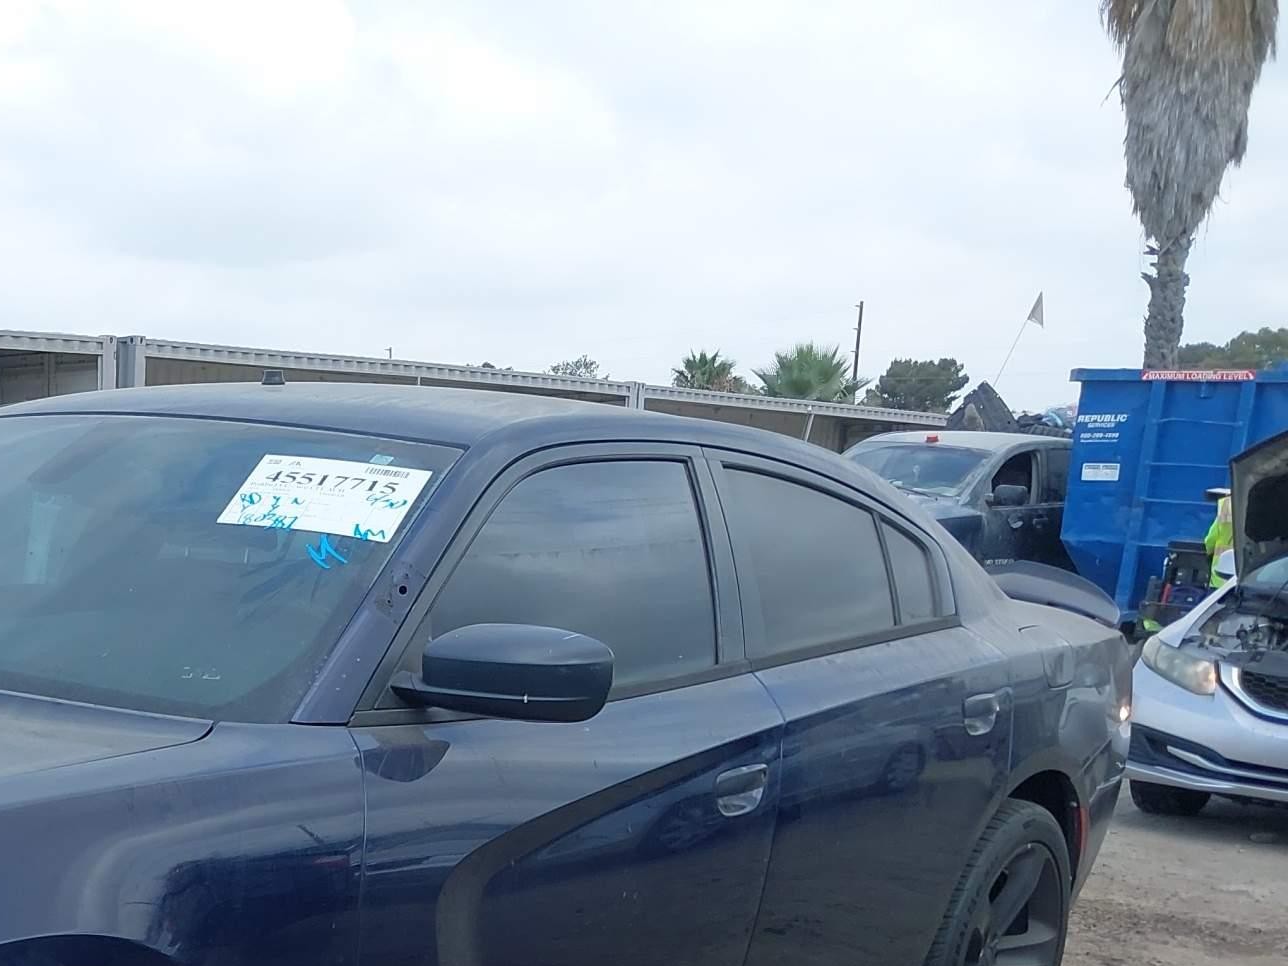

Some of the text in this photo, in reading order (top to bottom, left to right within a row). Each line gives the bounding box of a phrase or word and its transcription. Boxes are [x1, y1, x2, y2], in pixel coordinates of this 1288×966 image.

[1148, 372, 1249, 380] MAXIMUM LOADING LEVEL
[1077, 414, 1128, 423] REPUBLIC
[265, 470, 400, 495] 45517715
